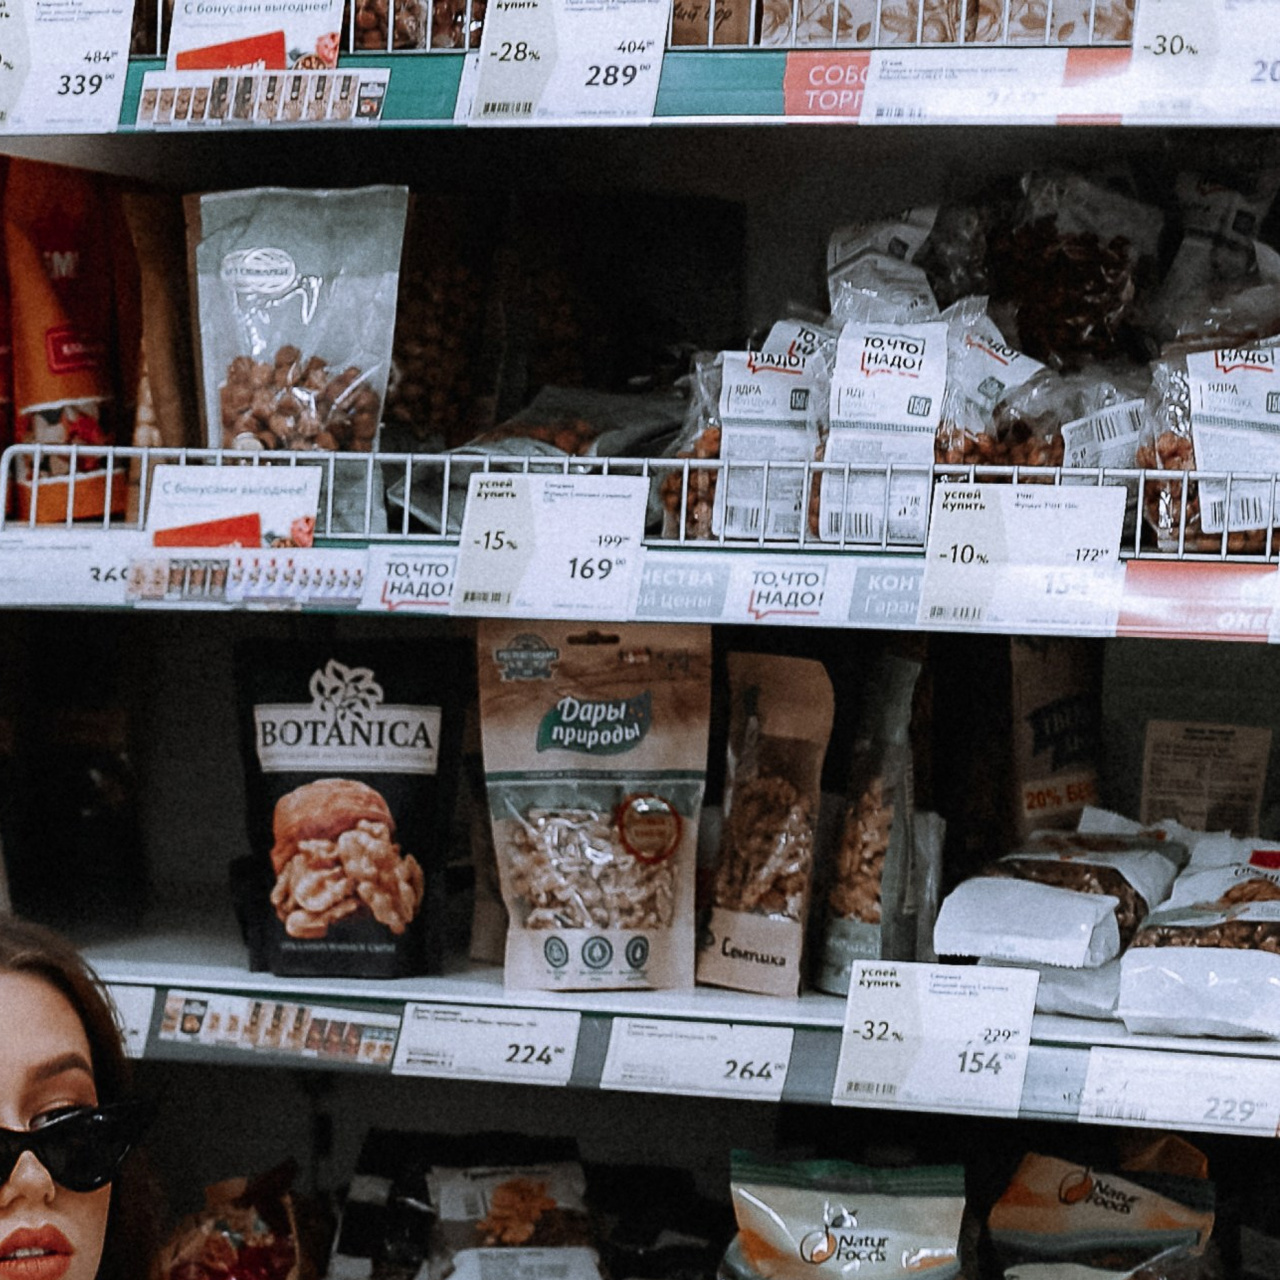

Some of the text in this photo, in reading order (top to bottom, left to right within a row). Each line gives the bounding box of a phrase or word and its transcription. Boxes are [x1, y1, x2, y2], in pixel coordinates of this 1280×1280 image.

[184, 3, 193, 15] С
[496, 1, 539, 12] купить
[489, 41, 541, 62] -28%
[1143, 33, 1200, 56] -30%
[57, 74, 103, 96] 339
[585, 65, 638, 87] 289
[476, 489, 517, 501] купить
[478, 479, 513, 490] успей
[944, 489, 982, 500] успей
[942, 500, 986, 512] купить
[473, 530, 518, 551] -15%
[939, 544, 990, 565] -10%
[386, 562, 450, 580] ТО,ЧТО
[568, 557, 614, 580] 169
[389, 580, 454, 598] НАДО!
[752, 570, 820, 589] ТО,ЧТО
[755, 590, 825, 608] НАДО!
[556, 696, 627, 727] Дары
[261, 718, 434, 750] BOTANICA
[551, 722, 641, 749] природы
[861, 967, 898, 978] успей
[858, 978, 902, 989] купить
[852, 1020, 904, 1042] -32%
[504, 1043, 553, 1065] 224
[958, 1050, 1003, 1076] 154
[723, 1058, 773, 1081] 264
[1203, 1097, 1255, 1124] 229
